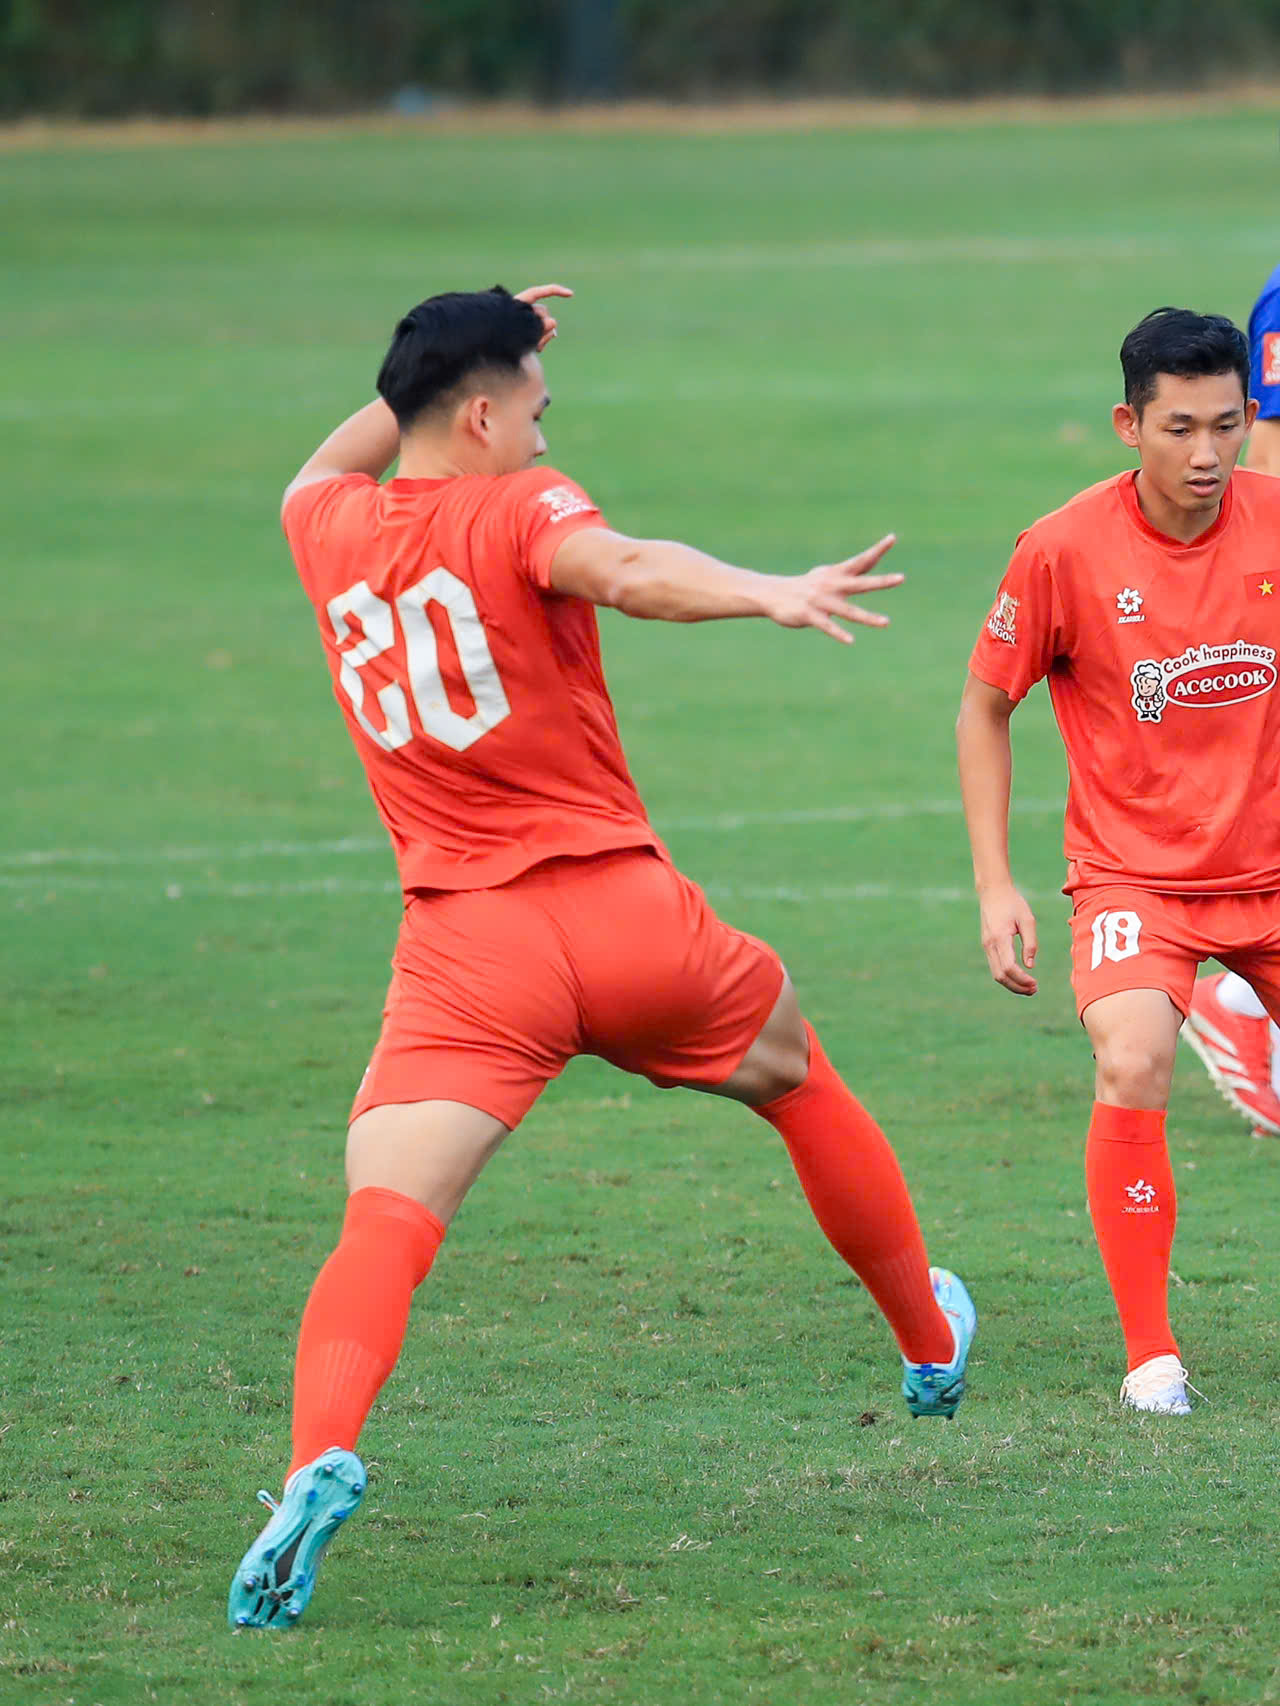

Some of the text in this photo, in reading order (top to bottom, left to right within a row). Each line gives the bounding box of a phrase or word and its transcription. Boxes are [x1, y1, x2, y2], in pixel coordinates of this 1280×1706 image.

[326, 566, 512, 752] 20
[1163, 643, 1274, 674] Cook happiness
[1090, 910, 1144, 971] 18
